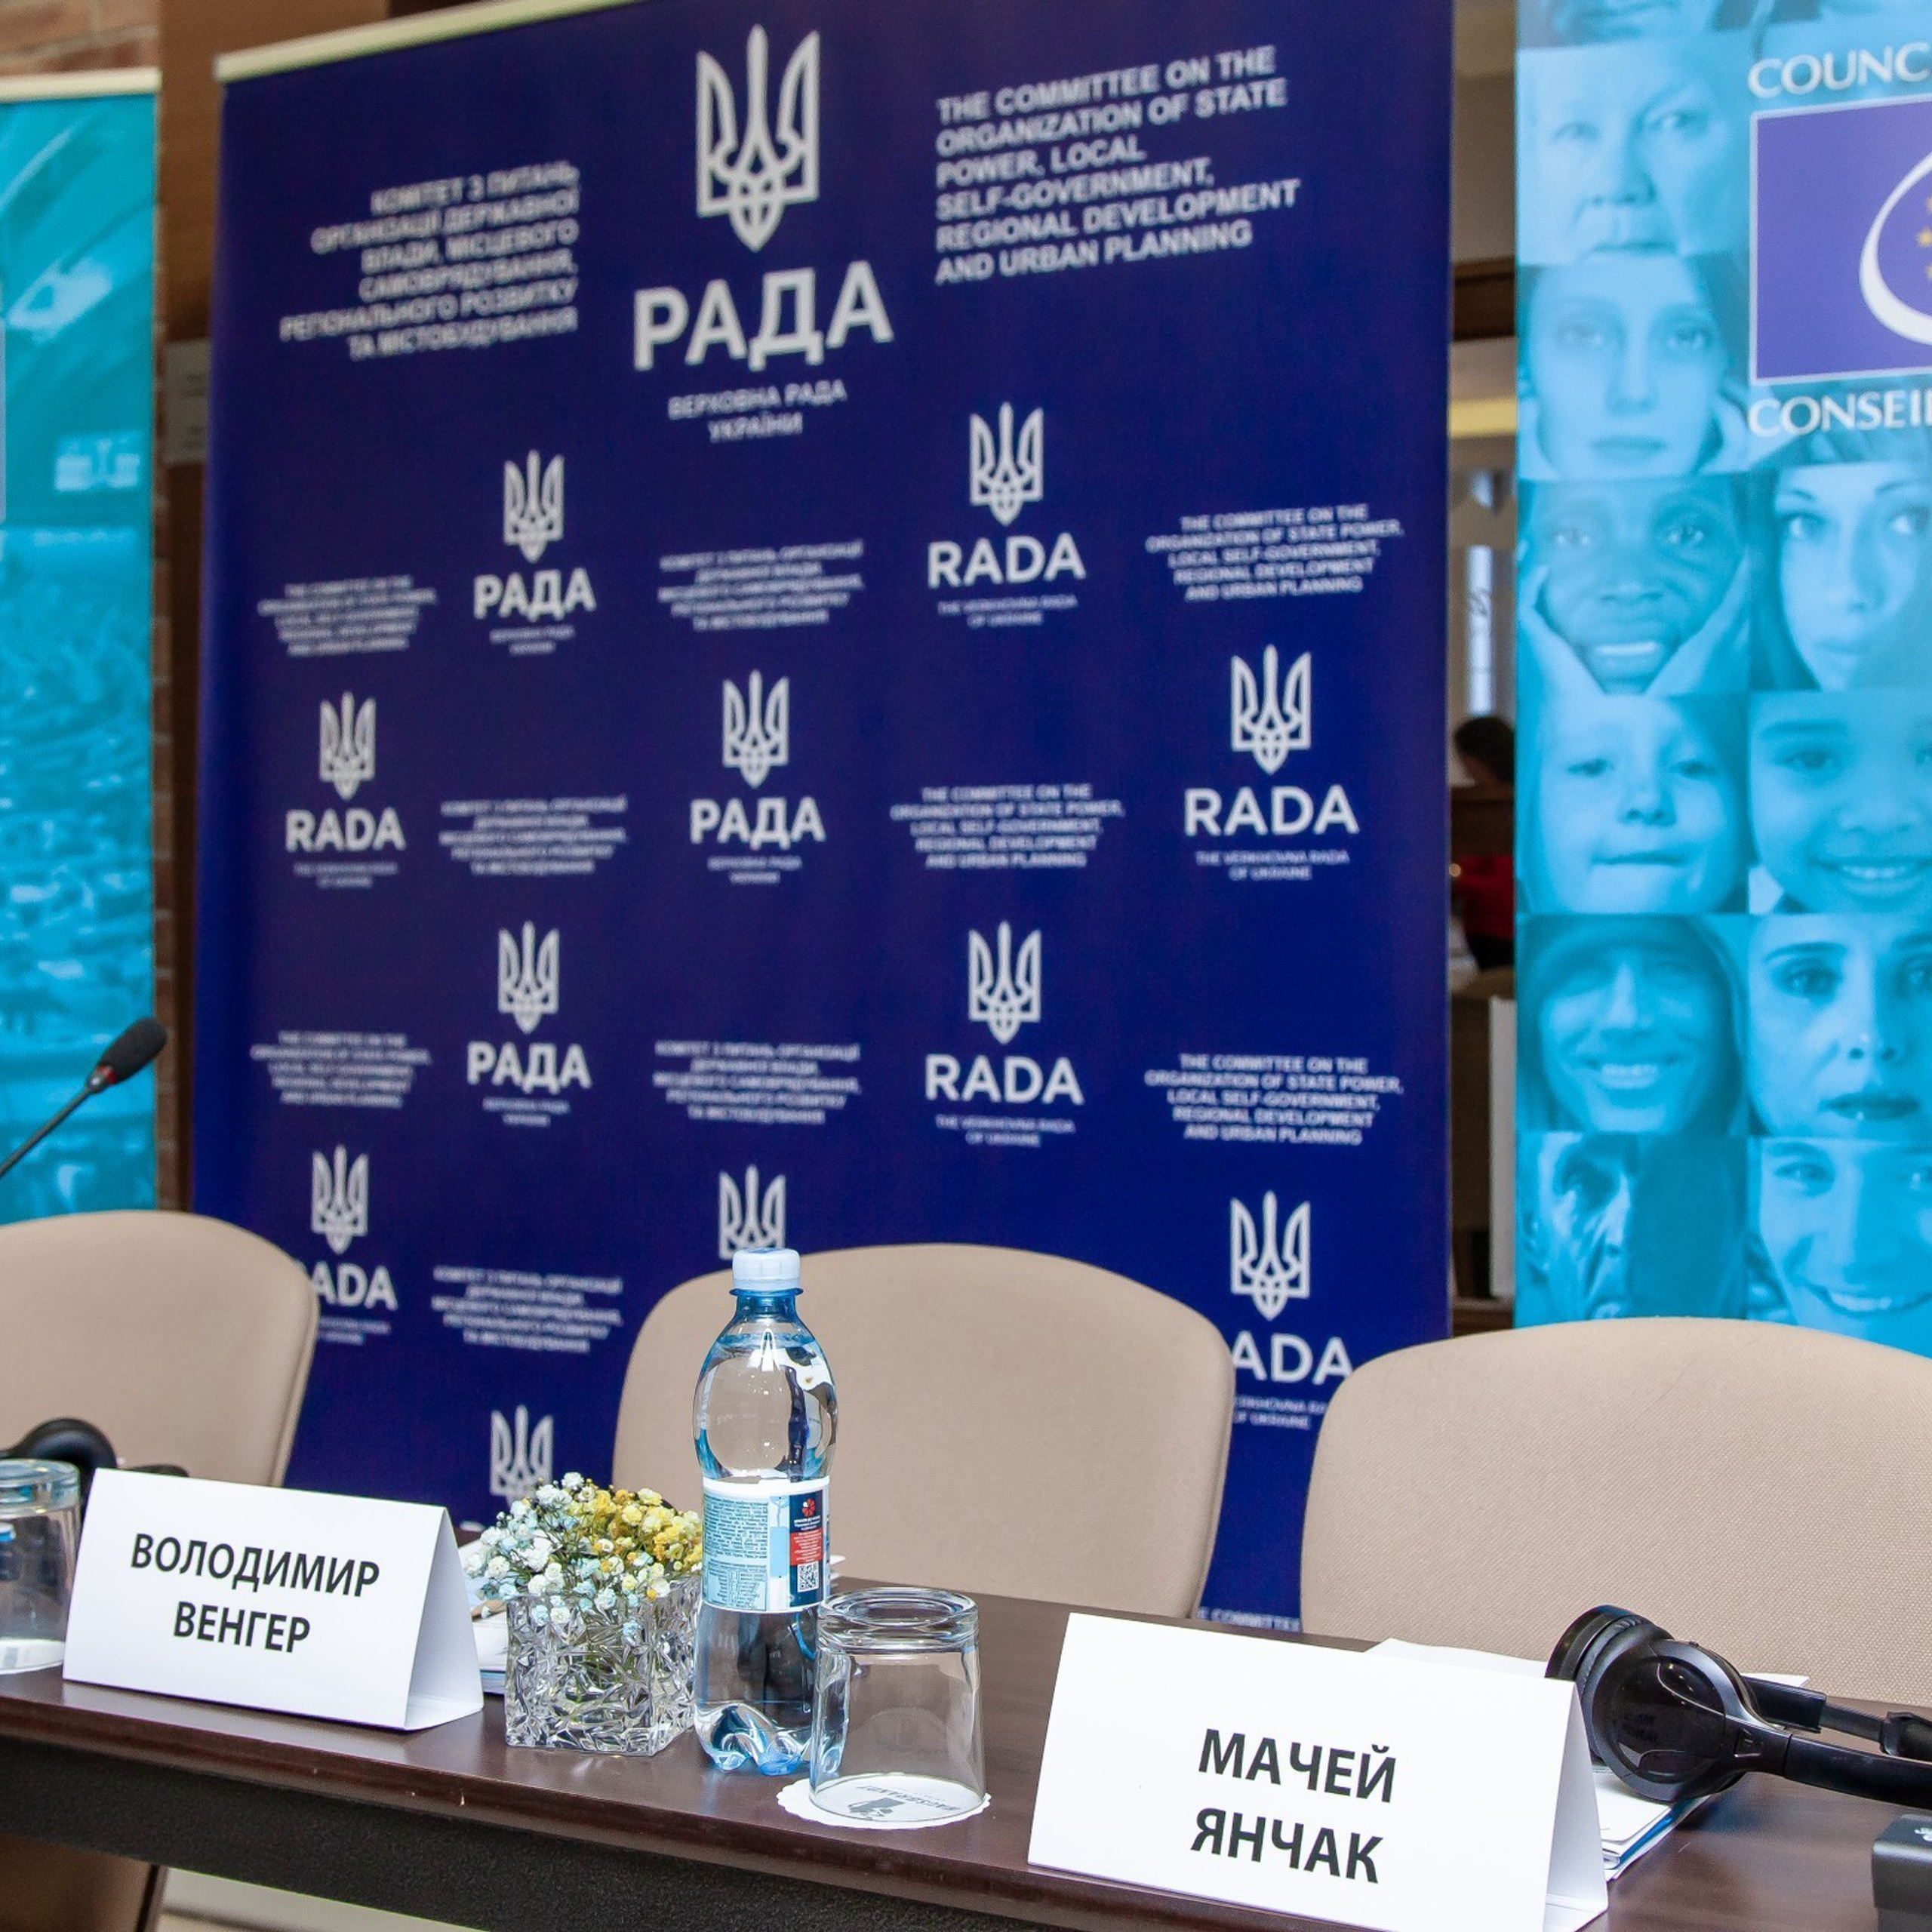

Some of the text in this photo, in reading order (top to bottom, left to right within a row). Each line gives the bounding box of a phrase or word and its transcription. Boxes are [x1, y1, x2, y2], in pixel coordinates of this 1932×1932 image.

[936, 45, 1276, 124] THE COMMITTEE ON THE
[1748, 42, 1930, 97] COUNC
[936, 77, 1287, 156] ORGANIZATION OF STATE
[936, 134, 1146, 189] POWER, LOCAL
[936, 177, 1301, 253] REGIONAL DEVELOPMENT
[935, 219, 1253, 285] AND URBAN PLANNING
[634, 260, 894, 371] РАДА
[784, 379, 848, 407] РАДА
[928, 532, 1086, 589] RADA
[473, 568, 597, 622] РАДА
[285, 806, 407, 853] RADA
[689, 796, 826, 851] РАДА
[1184, 784, 1360, 836] RADA
[467, 1041, 592, 1094] РАДА
[925, 1054, 1085, 1106] RADA
[311, 1261, 398, 1311] ADA
[1232, 1330, 1354, 1386] ADA
[131, 1534, 380, 1597] ВОЛОДИМИР
[174, 1601, 311, 1653] ВЕНГЕР
[1198, 1728, 1396, 1803] МАЧЕЙ
[1190, 1807, 1383, 1884] ЯНЧАК
